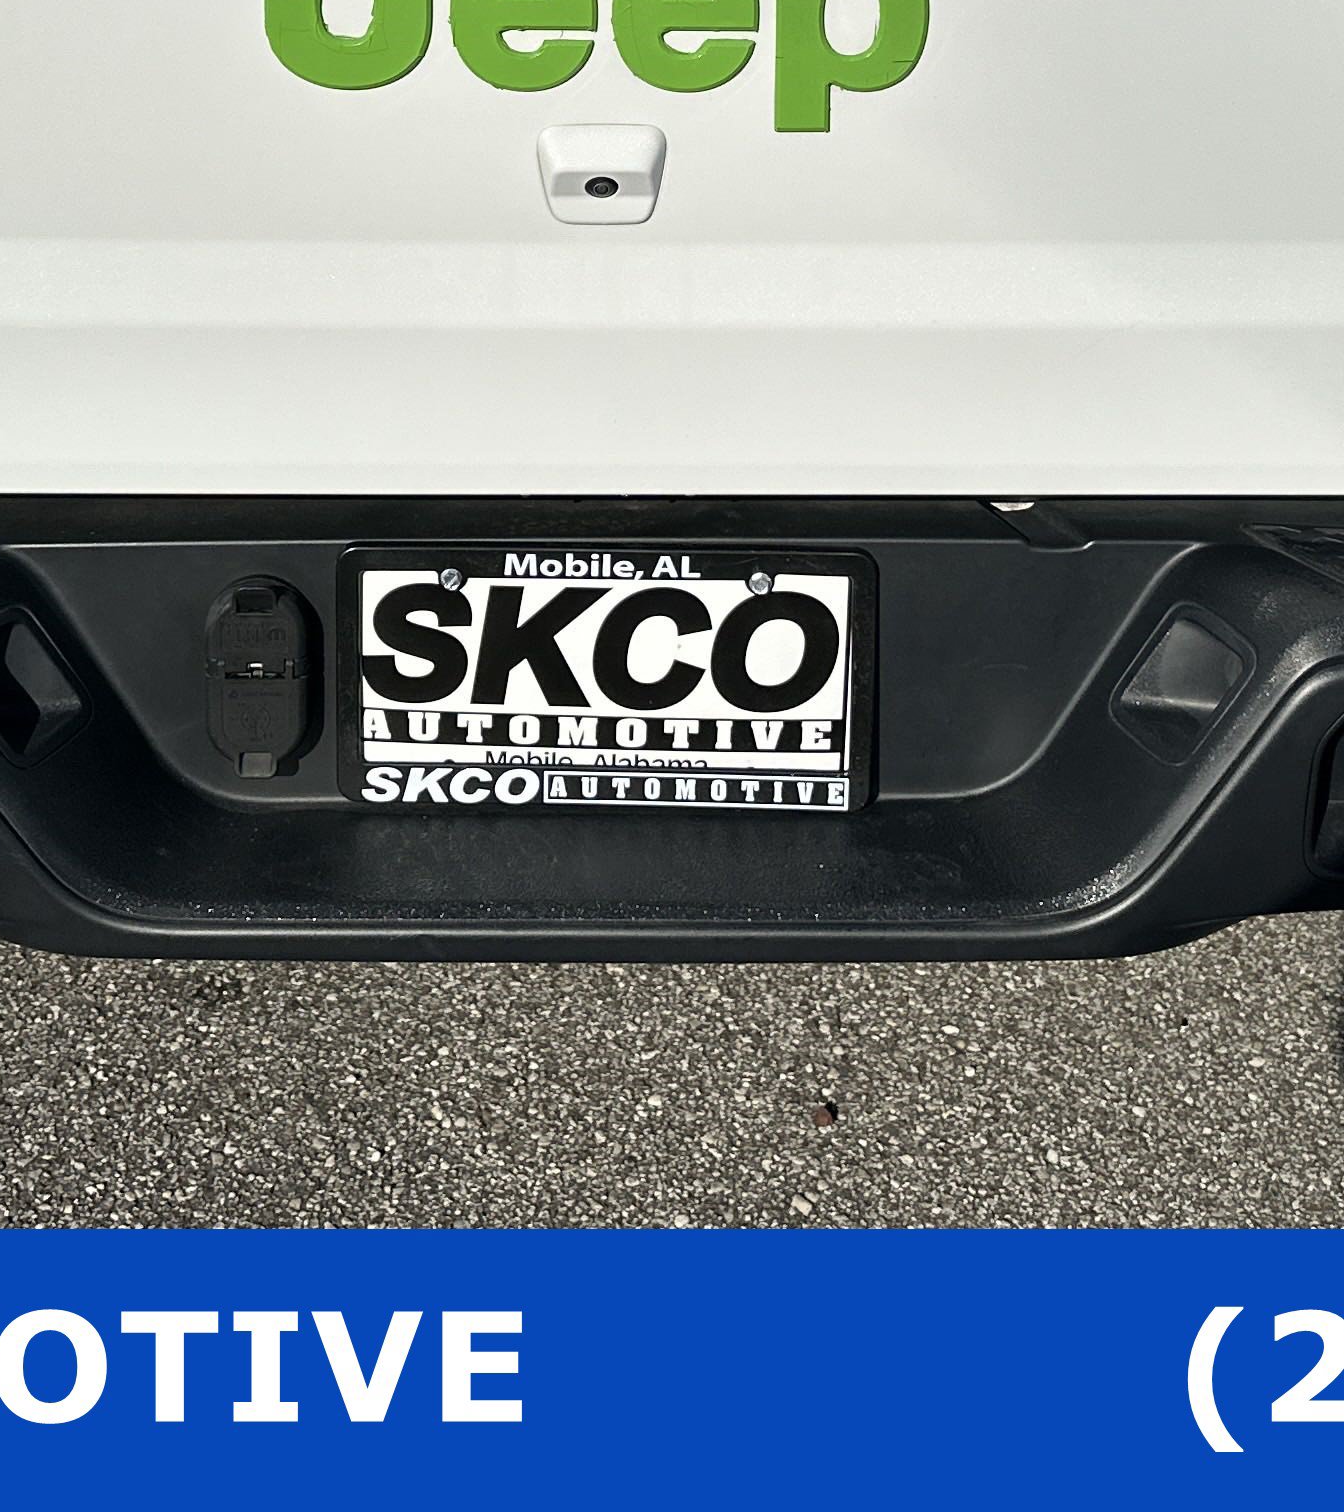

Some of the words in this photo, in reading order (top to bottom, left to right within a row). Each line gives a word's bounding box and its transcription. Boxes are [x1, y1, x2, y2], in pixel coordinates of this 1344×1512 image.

[503, 552, 644, 580] Mobile,
[651, 555, 701, 579] AL
[362, 582, 840, 713] SKCO
[363, 708, 833, 752] AUTOMOTIVE
[360, 766, 540, 804] SKCO
[549, 775, 844, 805] AUTOMOTIVE
